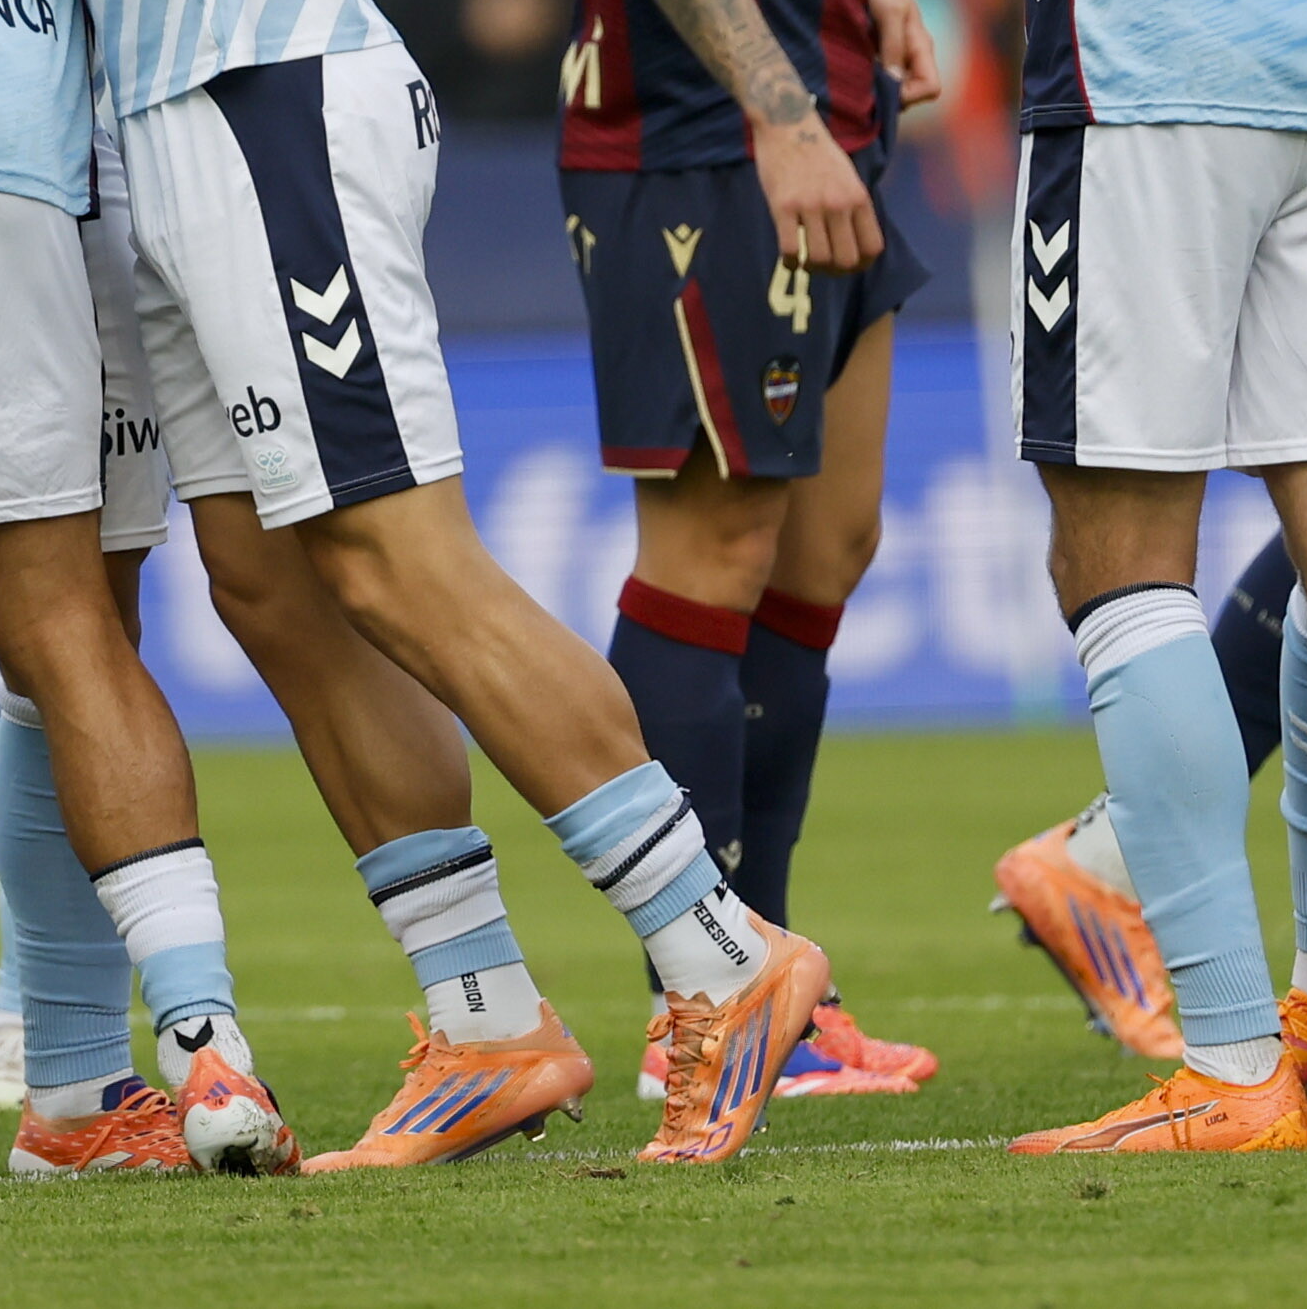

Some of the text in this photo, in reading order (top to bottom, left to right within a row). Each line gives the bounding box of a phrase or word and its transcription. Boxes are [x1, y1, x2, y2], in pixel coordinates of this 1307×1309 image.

[767, 225, 813, 334] 4
[693, 899, 750, 967] PEDESIGN
[460, 972, 487, 1013] ESIGN
[1204, 1112, 1229, 1127] LUCA
